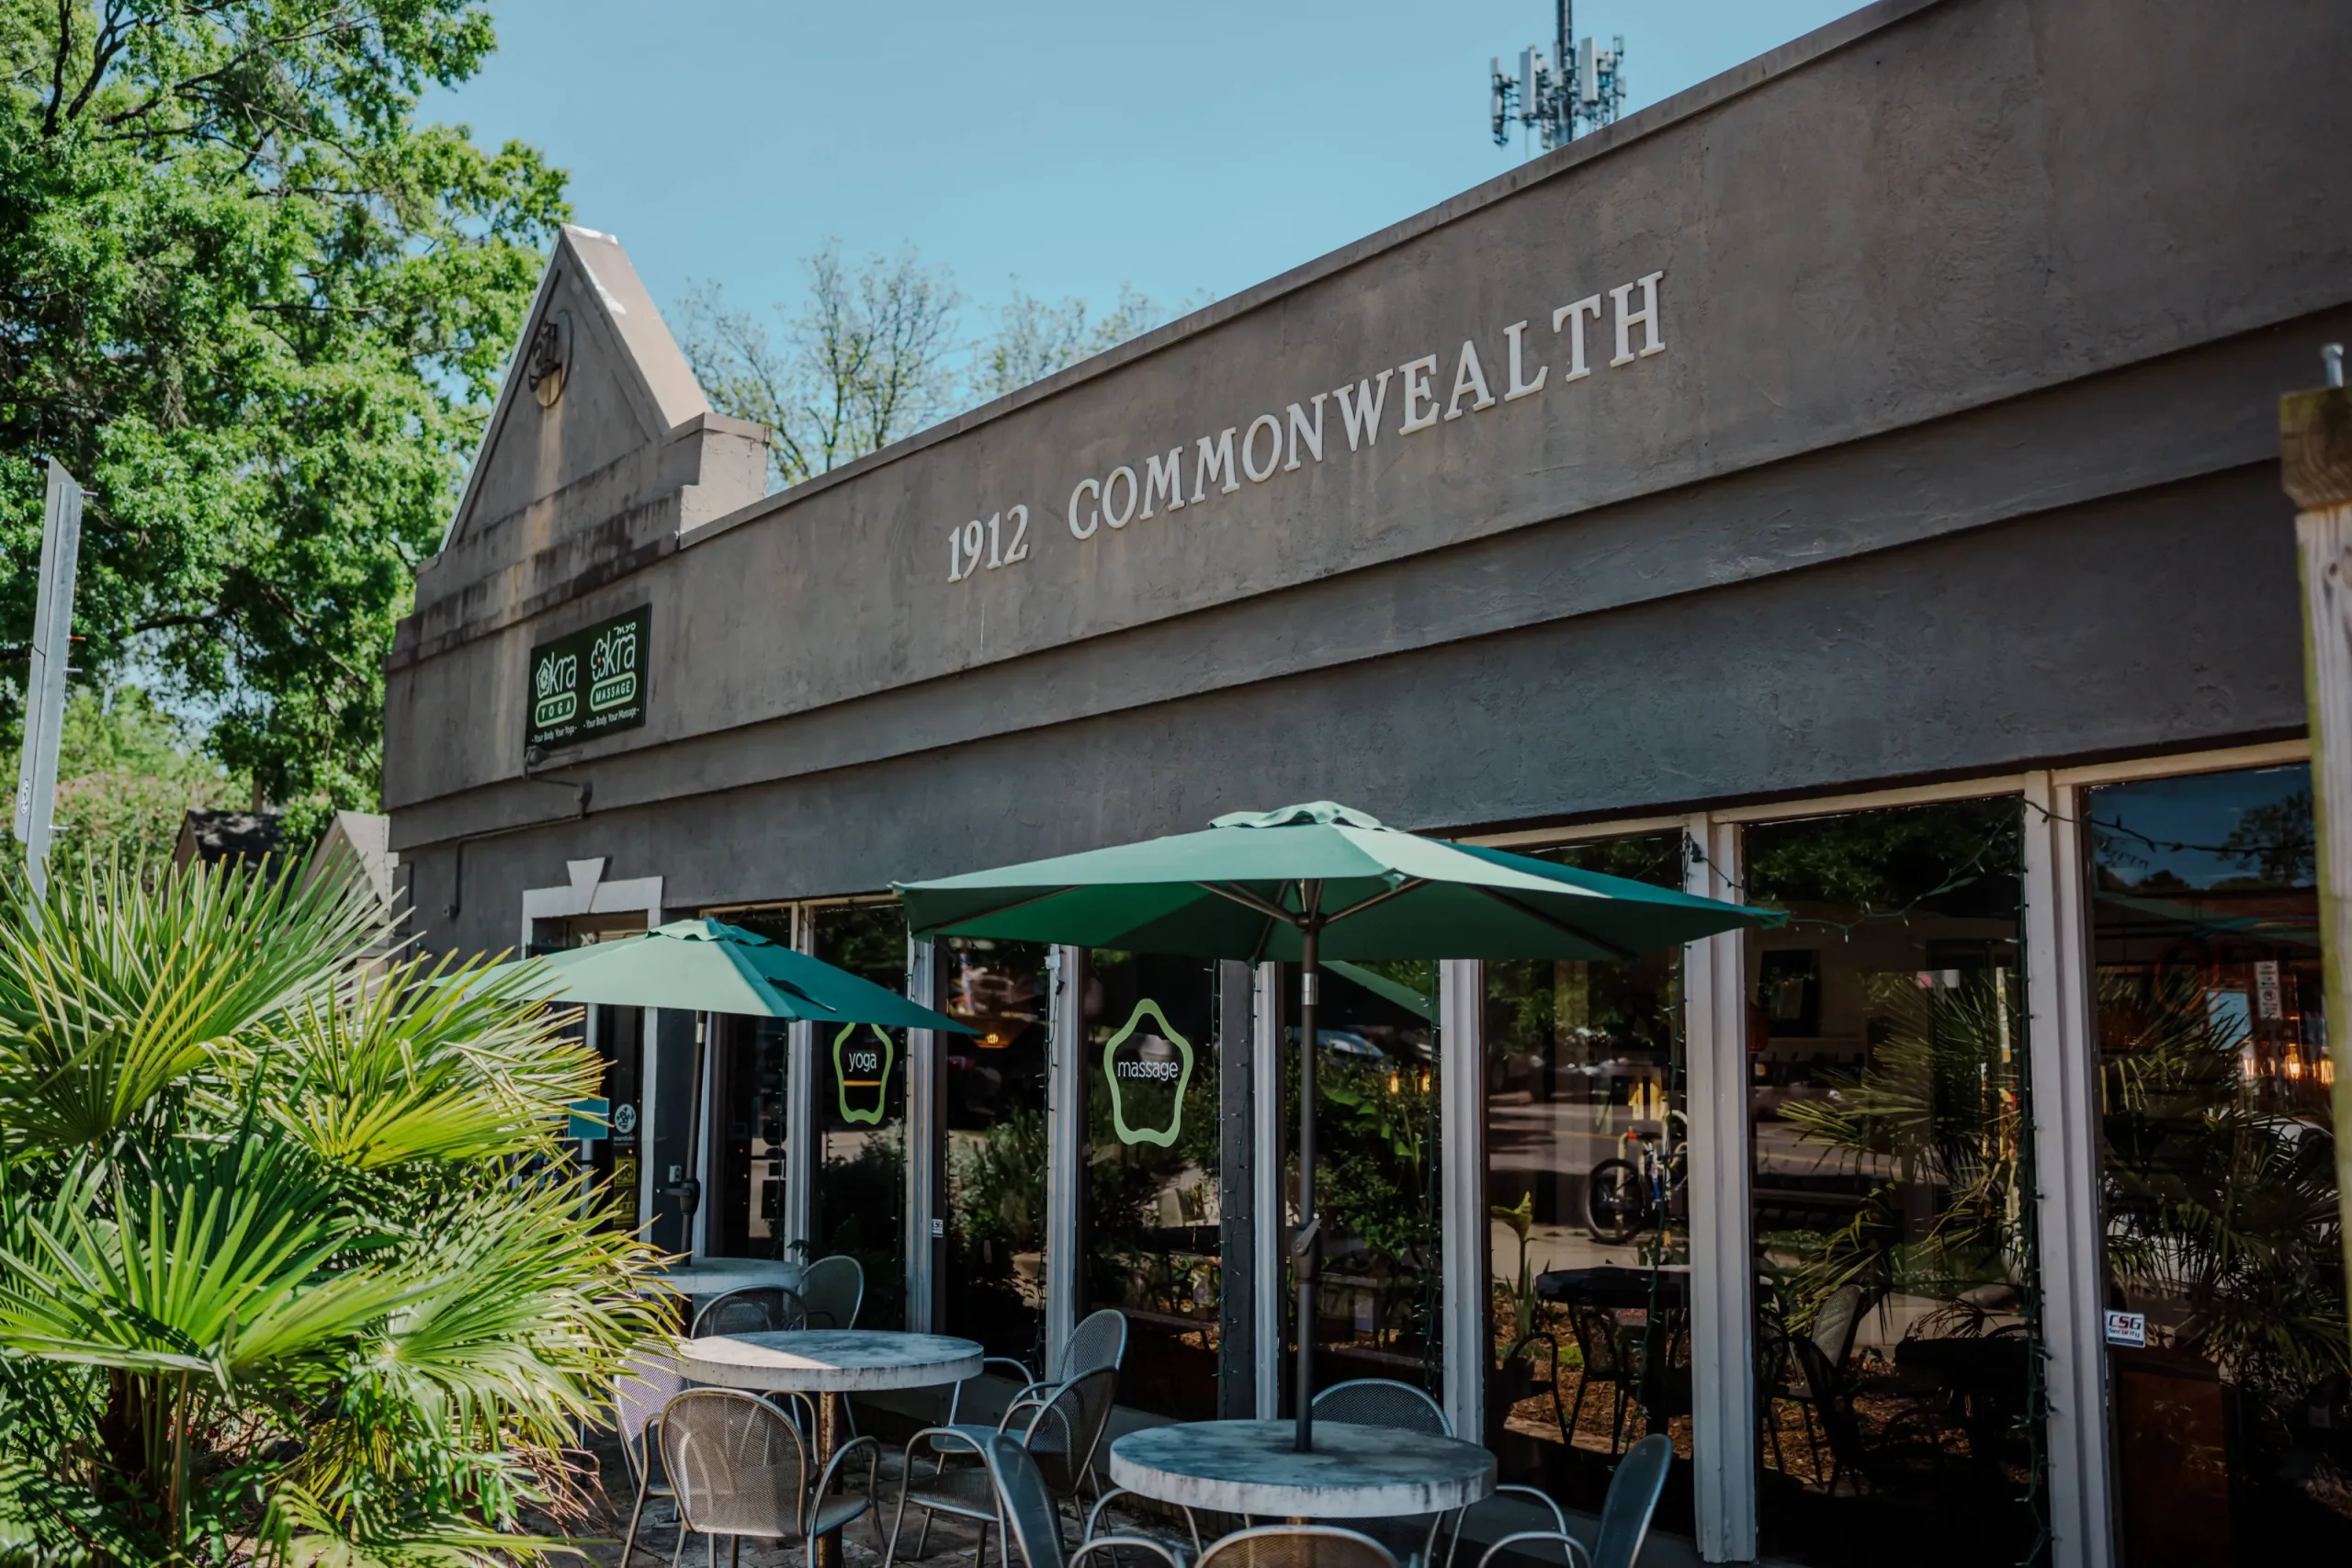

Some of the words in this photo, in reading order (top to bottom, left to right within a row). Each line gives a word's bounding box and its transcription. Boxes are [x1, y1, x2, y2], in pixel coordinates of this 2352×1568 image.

[948, 503, 1029, 583] 1912
[1069, 270, 1666, 540] COMMONWEALTH
[595, 680, 631, 703] MASSAGE
[541, 703, 571, 719] YOGA
[586, 719, 595, 728] Your
[608, 713, 618, 722] Your
[618, 706, 637, 720] Massage
[555, 728, 564, 737] Your
[848, 1051, 877, 1073] yoga
[1117, 1058, 1179, 1081] massage
[2109, 1314, 2143, 1329] CSG
